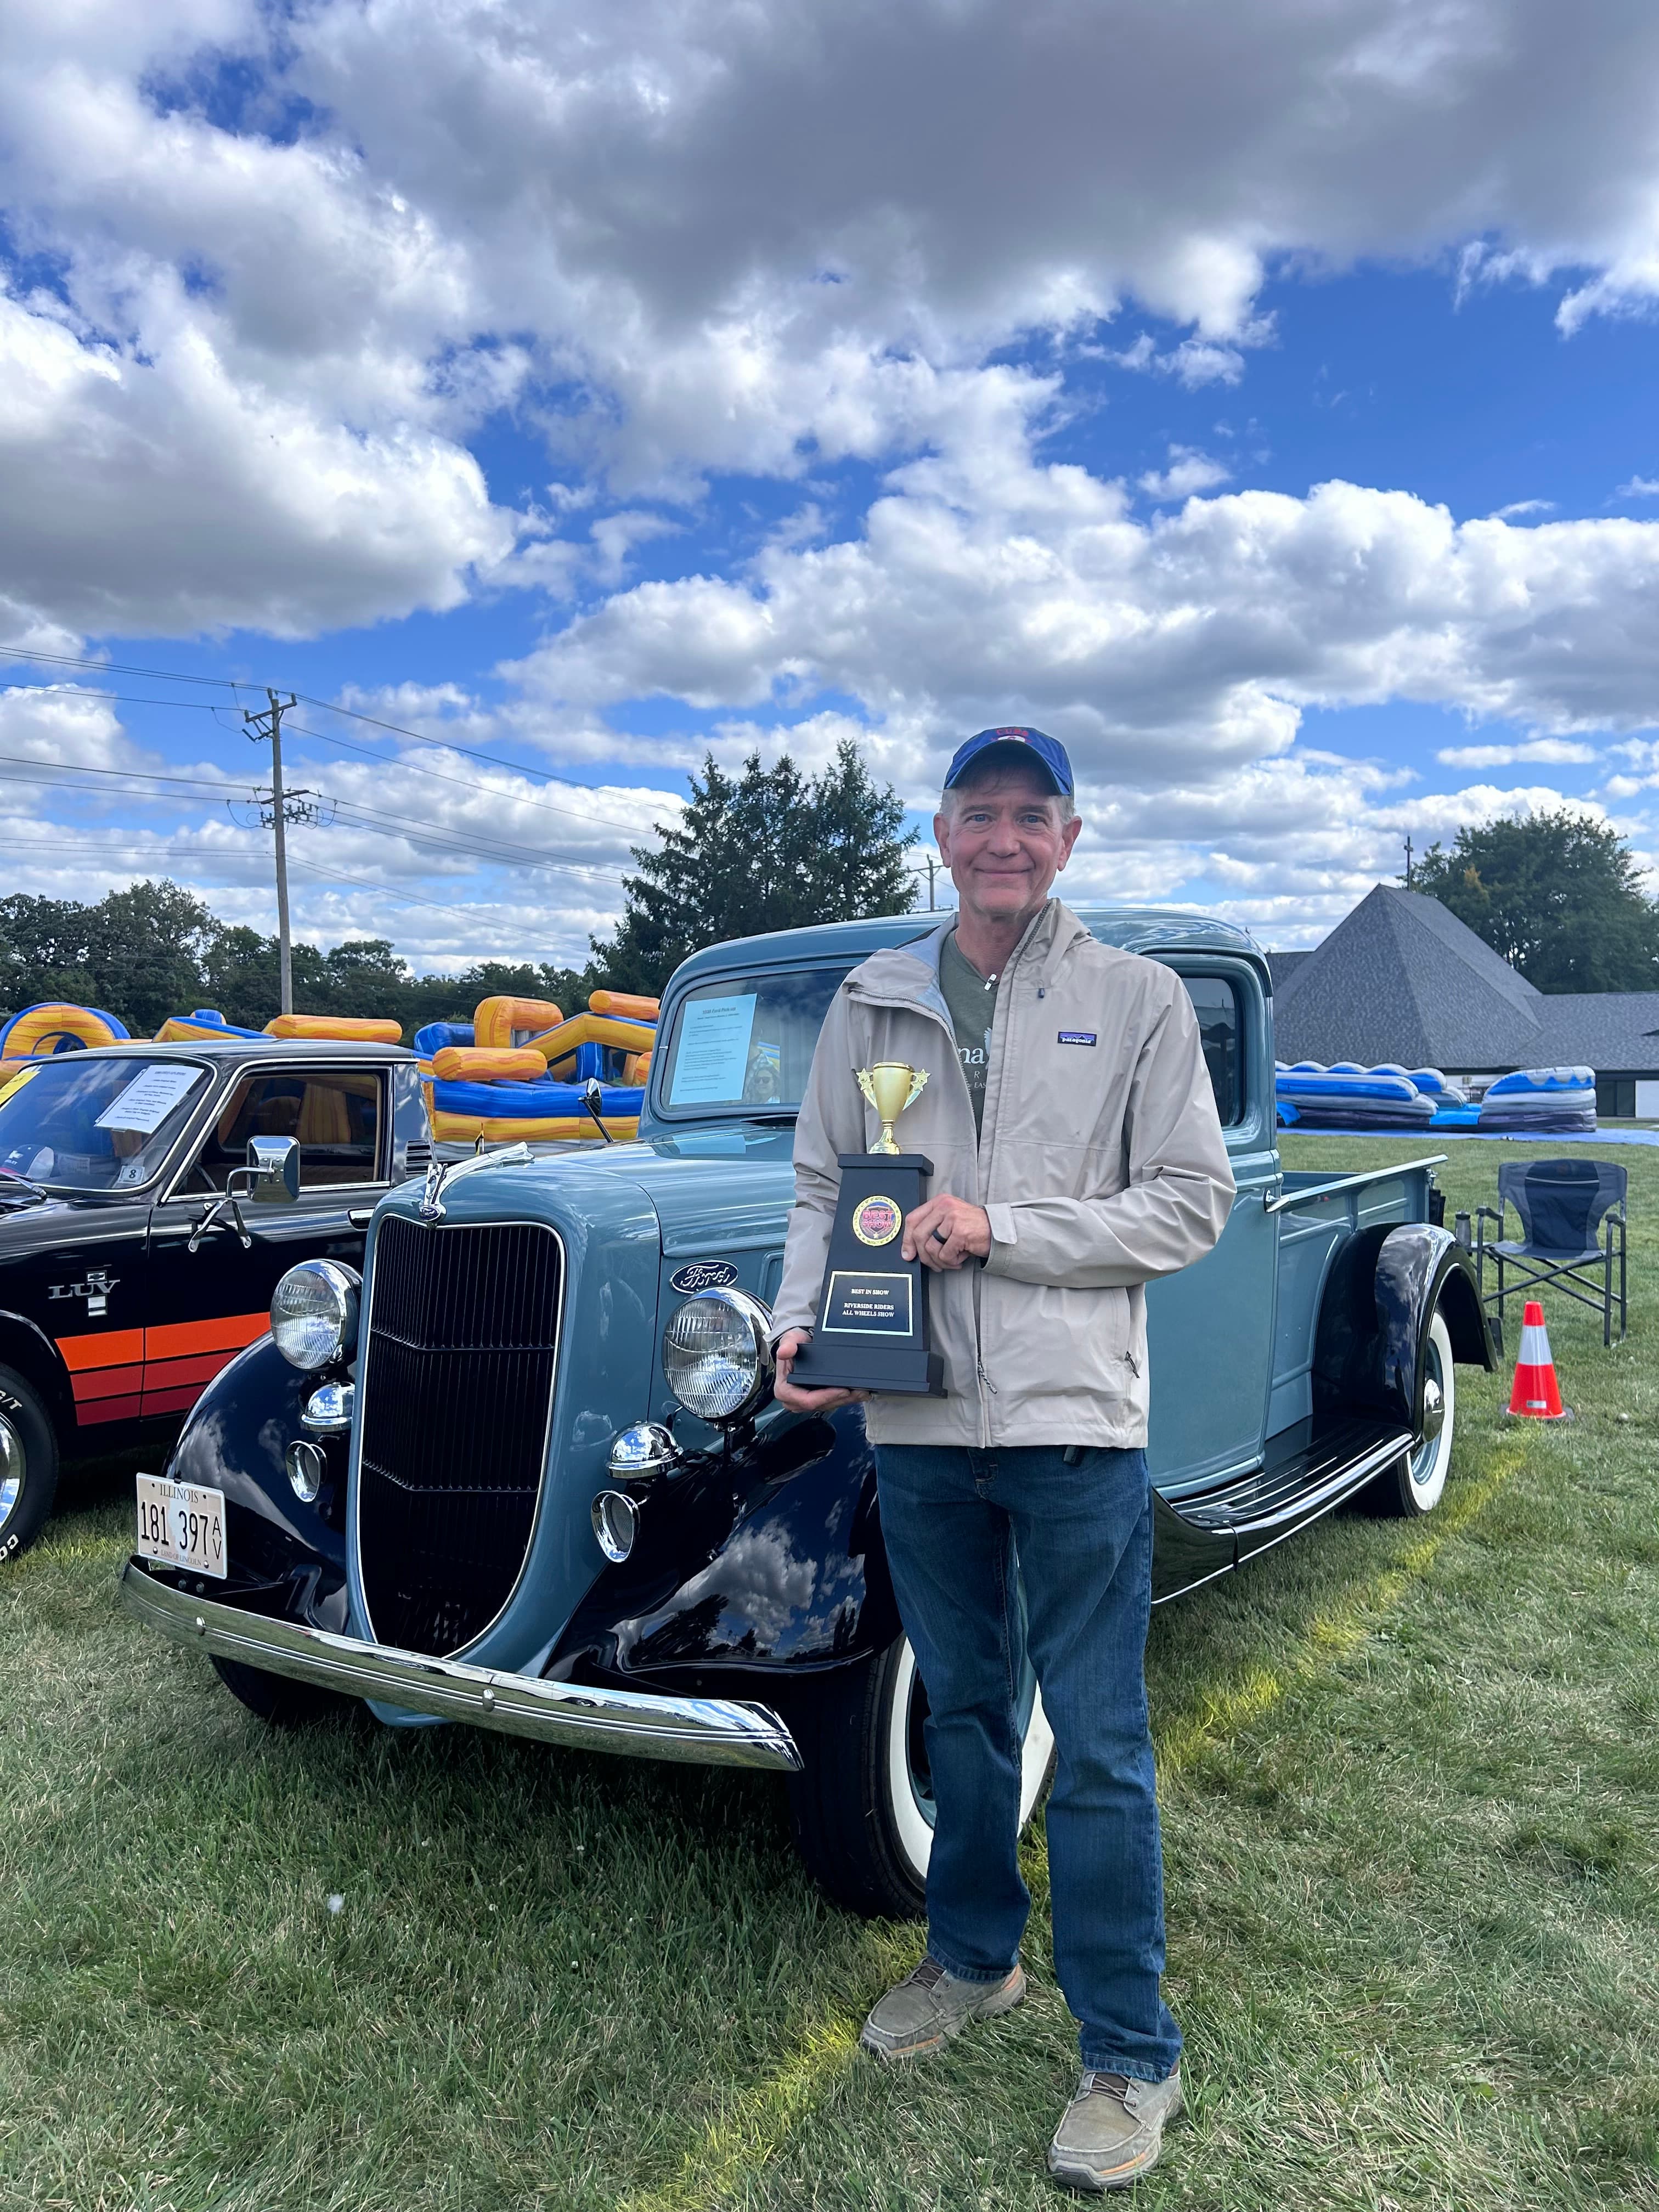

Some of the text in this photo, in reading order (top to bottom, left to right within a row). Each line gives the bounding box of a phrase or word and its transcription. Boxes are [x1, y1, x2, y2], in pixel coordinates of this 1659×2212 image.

[129, 1169, 136, 1178] 8
[862, 1210, 894, 1221] BEST
[863, 1220, 893, 1229] SHOW
[680, 1264, 730, 1288] Ford
[48, 1279, 120, 1299] LUV
[160, 1483, 199, 1503] ILLINOIS
[141, 1502, 170, 1546] 181
[179, 1510, 208, 1555] 397
[161, 1549, 173, 1559] LAND
[179, 1554, 201, 1566] LINCOLN
